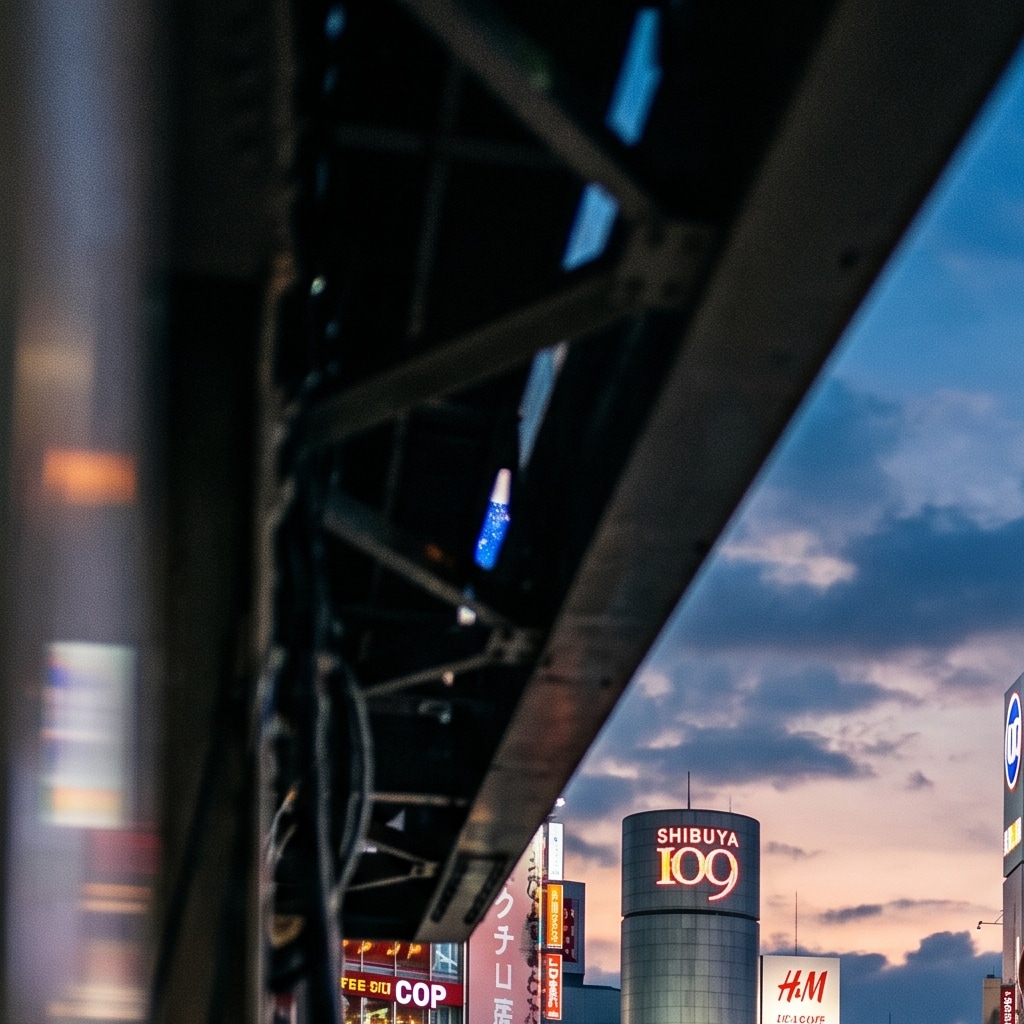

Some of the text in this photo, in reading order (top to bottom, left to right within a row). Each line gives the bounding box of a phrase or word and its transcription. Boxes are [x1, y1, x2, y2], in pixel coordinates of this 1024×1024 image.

[657, 827, 739, 848] SHIBUYA
[656, 846, 739, 901] 109
[395, 979, 447, 1009] COP
[777, 969, 828, 1003] H&M
